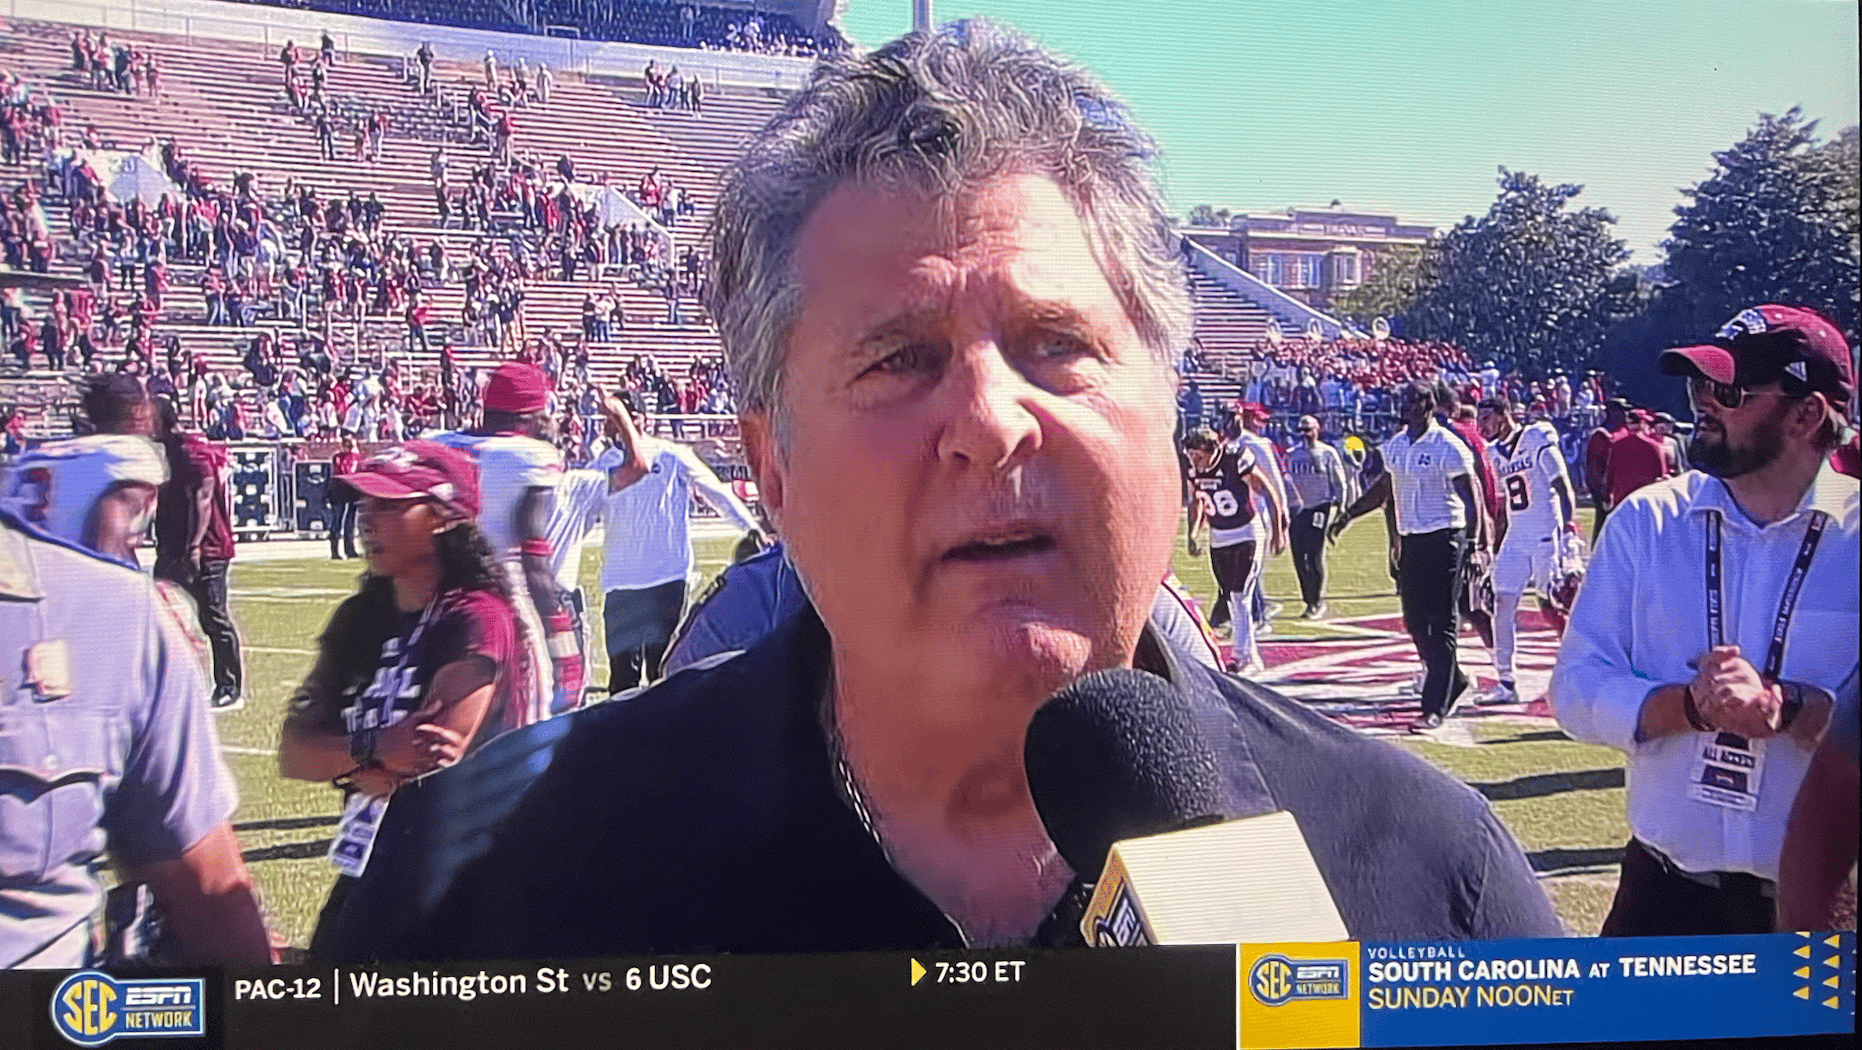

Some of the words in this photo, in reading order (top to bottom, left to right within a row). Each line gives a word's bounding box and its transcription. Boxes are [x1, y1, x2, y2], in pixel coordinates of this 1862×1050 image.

[1367, 946, 1466, 960] VOLLEYBALL
[935, 961, 988, 983] 7:30
[994, 961, 1026, 983] ET
[1296, 966, 1340, 979] ESPN
[1368, 961, 1452, 983] SOUTH
[1457, 958, 1581, 981] CAROLINA
[1588, 962, 1611, 978] AT
[1618, 953, 1757, 978] TENNESSEE
[234, 977, 322, 1000] PAC-12
[349, 970, 527, 1001] Washington
[536, 967, 570, 993] St
[625, 967, 642, 991] 6
[649, 963, 712, 990] USC
[1256, 960, 1292, 1000] SEC
[1295, 982, 1340, 995] NETWORK
[125, 986, 192, 1006] ESPN
[1367, 985, 1471, 1010] SUNDAY
[62, 979, 118, 1036] SEC
[125, 1010, 193, 1029] NETWORK
